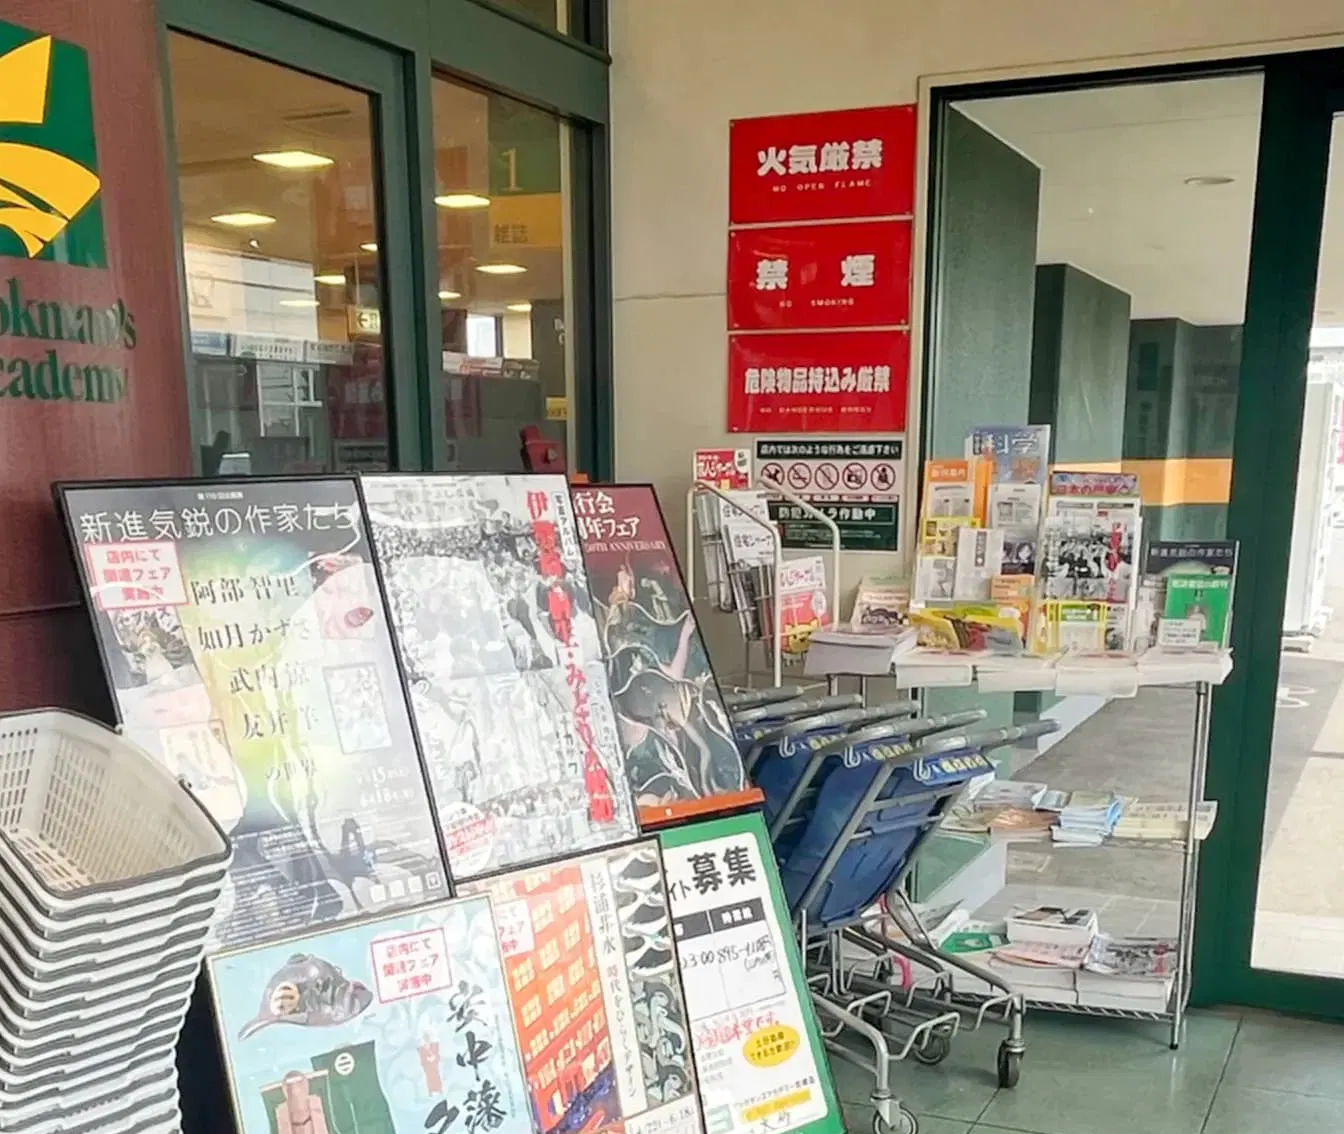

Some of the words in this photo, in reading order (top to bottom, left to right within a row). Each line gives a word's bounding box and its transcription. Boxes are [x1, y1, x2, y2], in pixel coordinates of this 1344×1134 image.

[757, 138, 882, 177] 火気厳禁
[797, 183, 825, 191] OPEN
[834, 179, 871, 189] FLAME
[811, 297, 854, 306] SMOKING
[745, 365, 891, 394] 危険物品持込み厳禁
[80, 503, 359, 546] 新進気鋭の作家たち
[665, 846, 756, 902] イト募集
